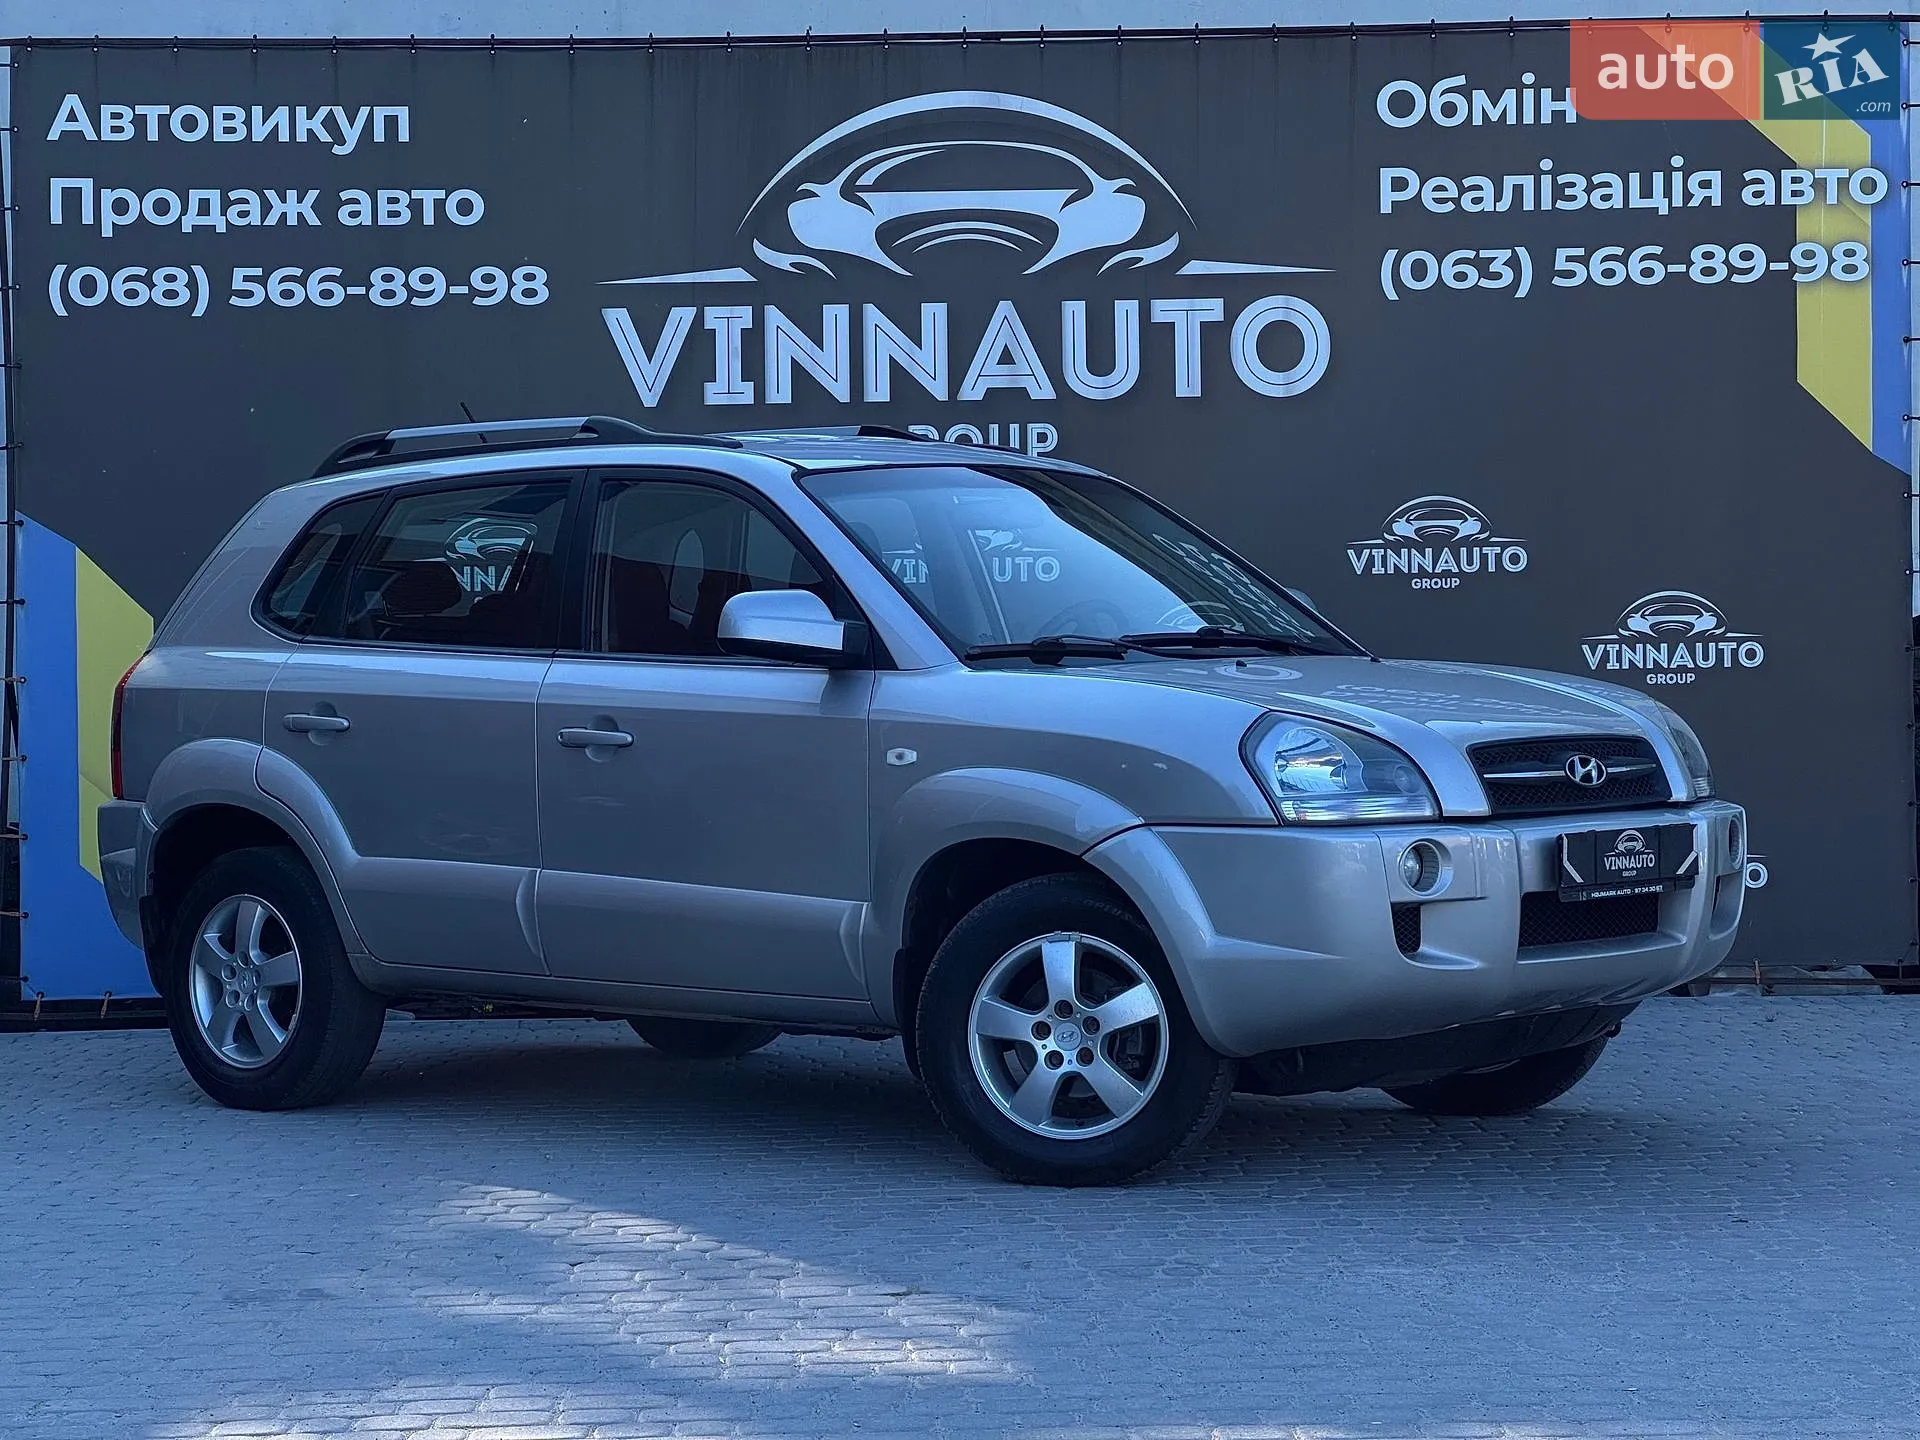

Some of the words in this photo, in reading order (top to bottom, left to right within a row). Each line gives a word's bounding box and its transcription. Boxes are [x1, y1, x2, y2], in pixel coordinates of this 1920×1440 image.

[47, 94, 410, 155] Автовикуп
[1376, 72, 1577, 128] Обмін
[49, 177, 321, 237] Продаж
[337, 189, 485, 226] авто
[1380, 155, 1722, 215] Реалізація
[1741, 167, 1888, 207] авто
[48, 265, 210, 317] (068)
[228, 265, 550, 307] 566-89-98
[1380, 246, 1533, 300] (063)
[1552, 241, 1870, 287] 566-89-98
[601, 294, 1332, 408] VINNAUTO
[1347, 546, 1528, 575] VINNAUTO
[1411, 577, 1461, 589] GROUP
[1581, 641, 1765, 670] VINNAUTO
[1646, 673, 1696, 685] GROUP
[1604, 853, 1655, 870] VINNAUTO
